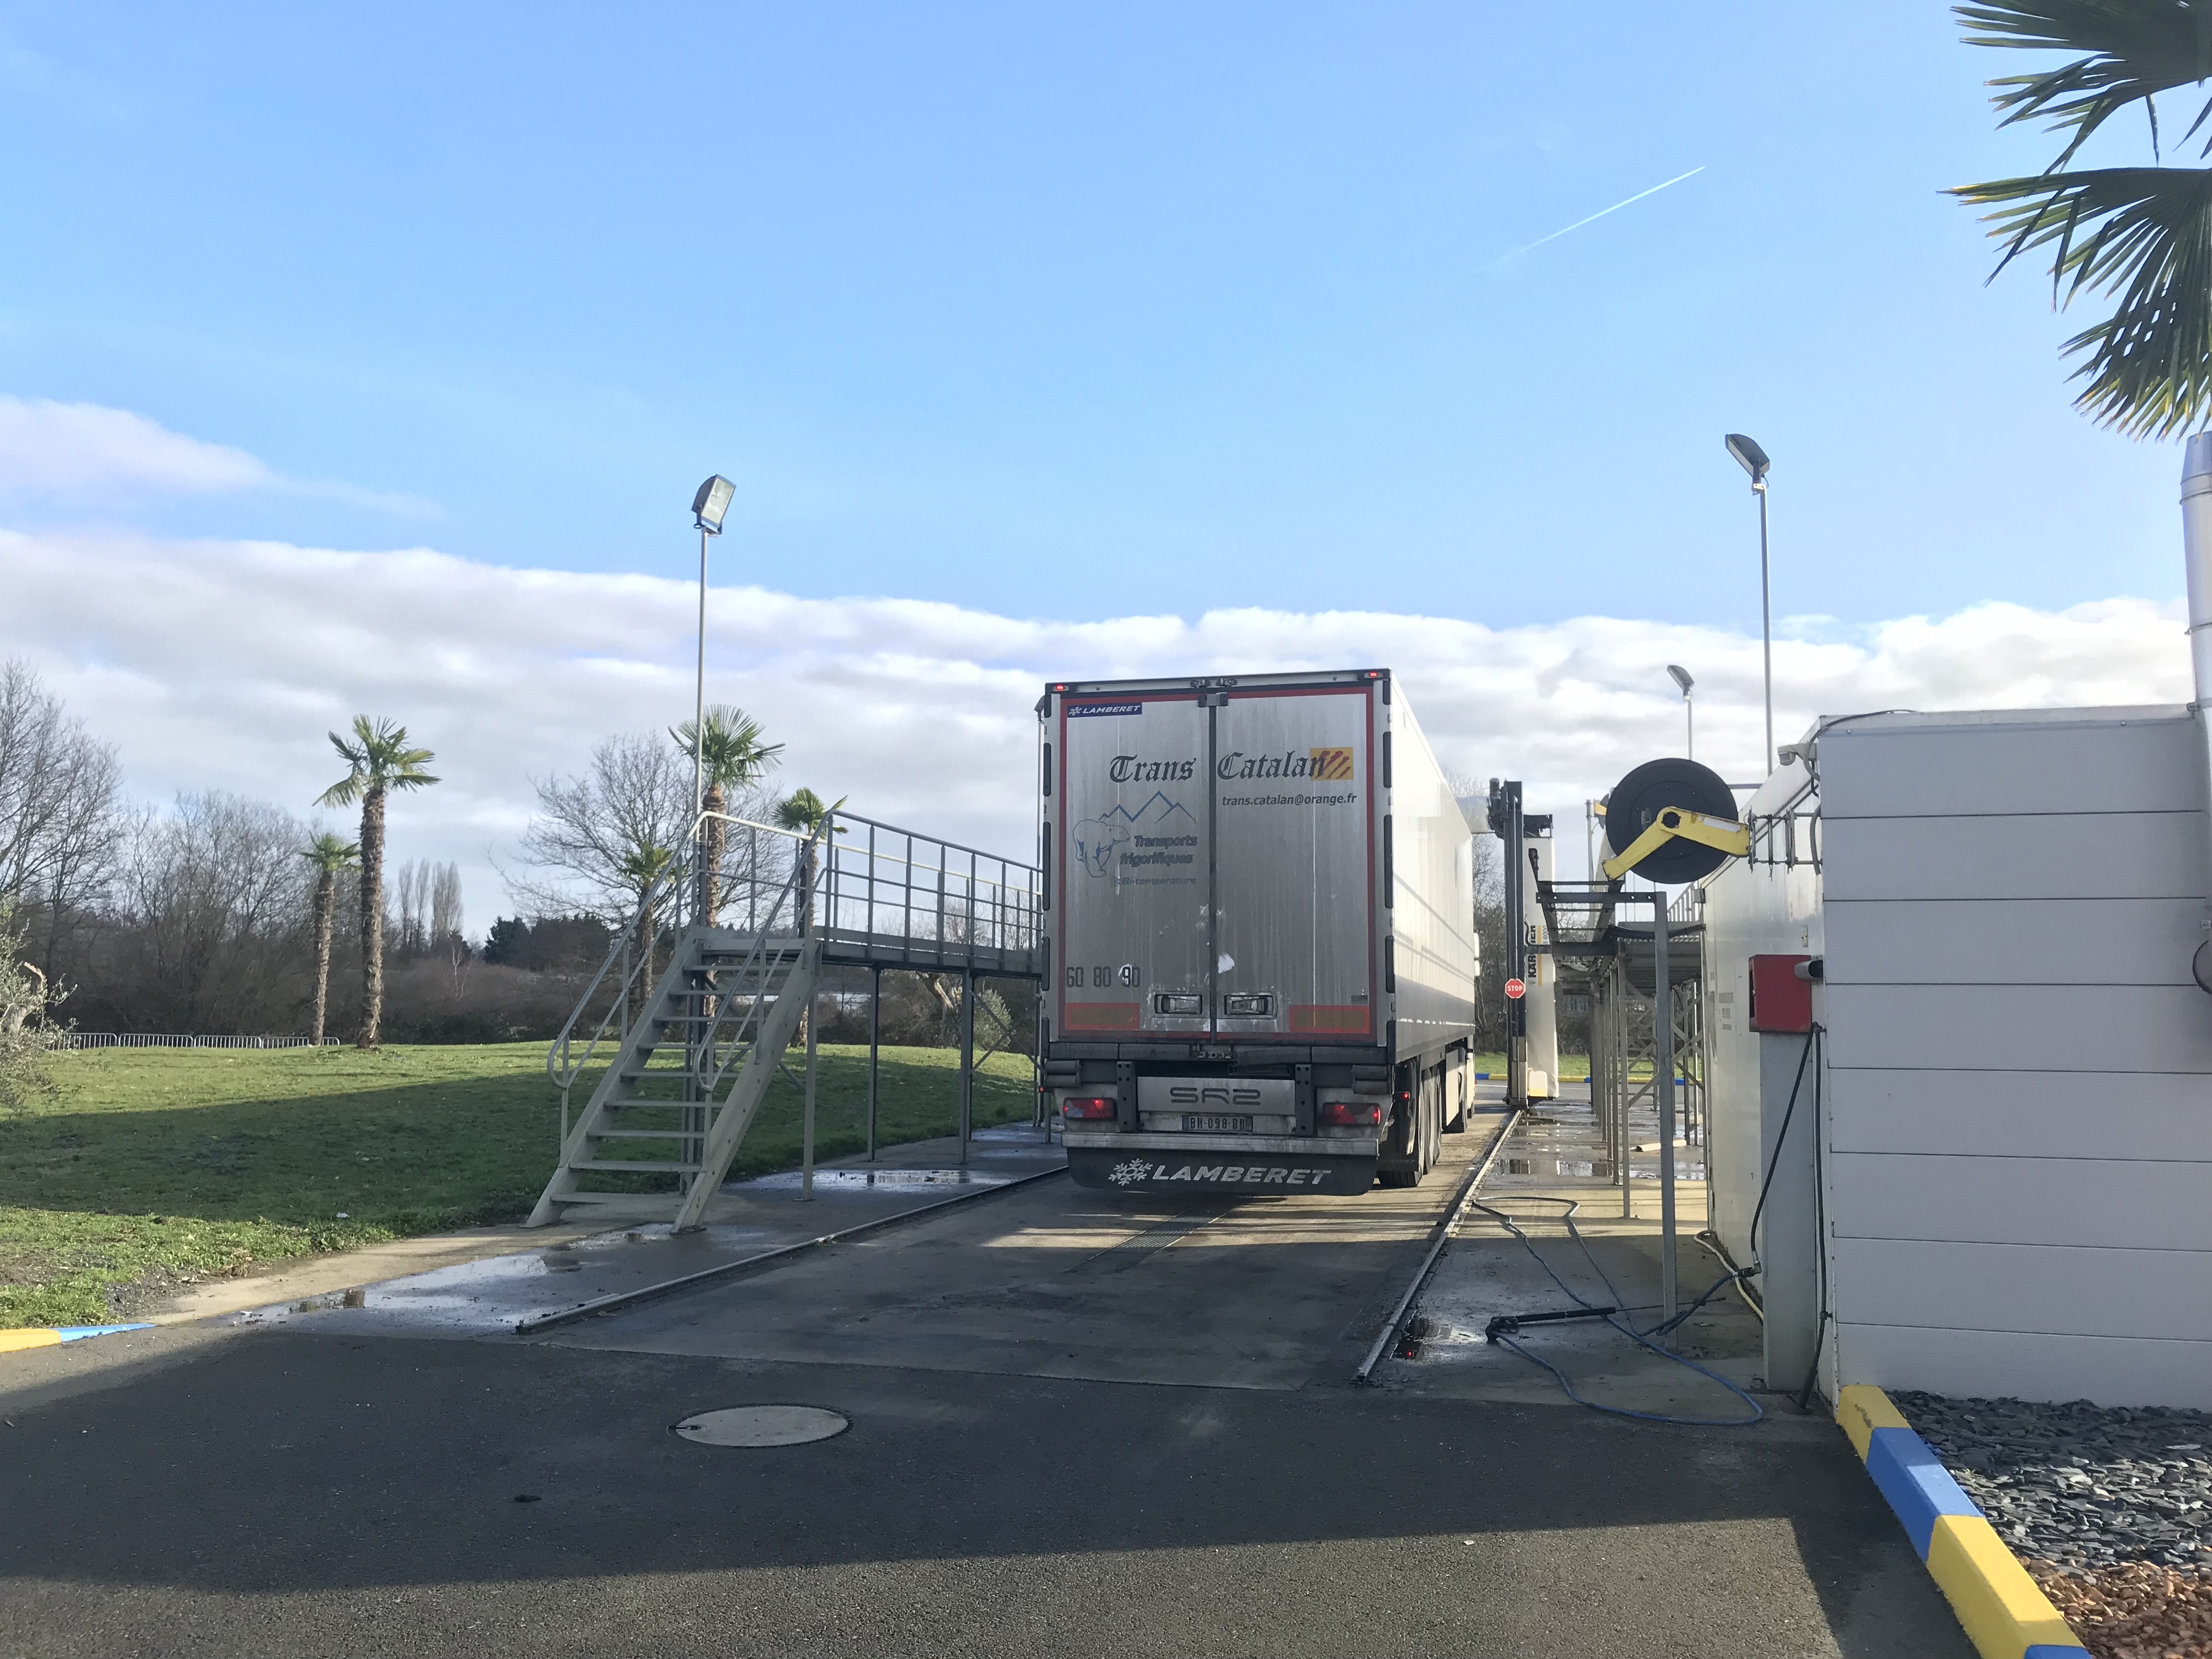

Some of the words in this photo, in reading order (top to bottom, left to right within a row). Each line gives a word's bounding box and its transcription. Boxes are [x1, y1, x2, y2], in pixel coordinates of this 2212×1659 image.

[1082, 706, 1141, 714] LAMBERET
[1109, 754, 1197, 783] Trans
[1217, 751, 1328, 780] Catalan
[1222, 793, 1357, 806] trans.catalan@orange.fr
[1135, 834, 1198, 849] Transports
[1120, 851, 1194, 867] frigorifiques
[1066, 967, 1084, 988] 60
[1093, 966, 1111, 988] 80
[1122, 967, 1141, 988] 90
[1152, 1165, 1332, 1184] LAMBERET
